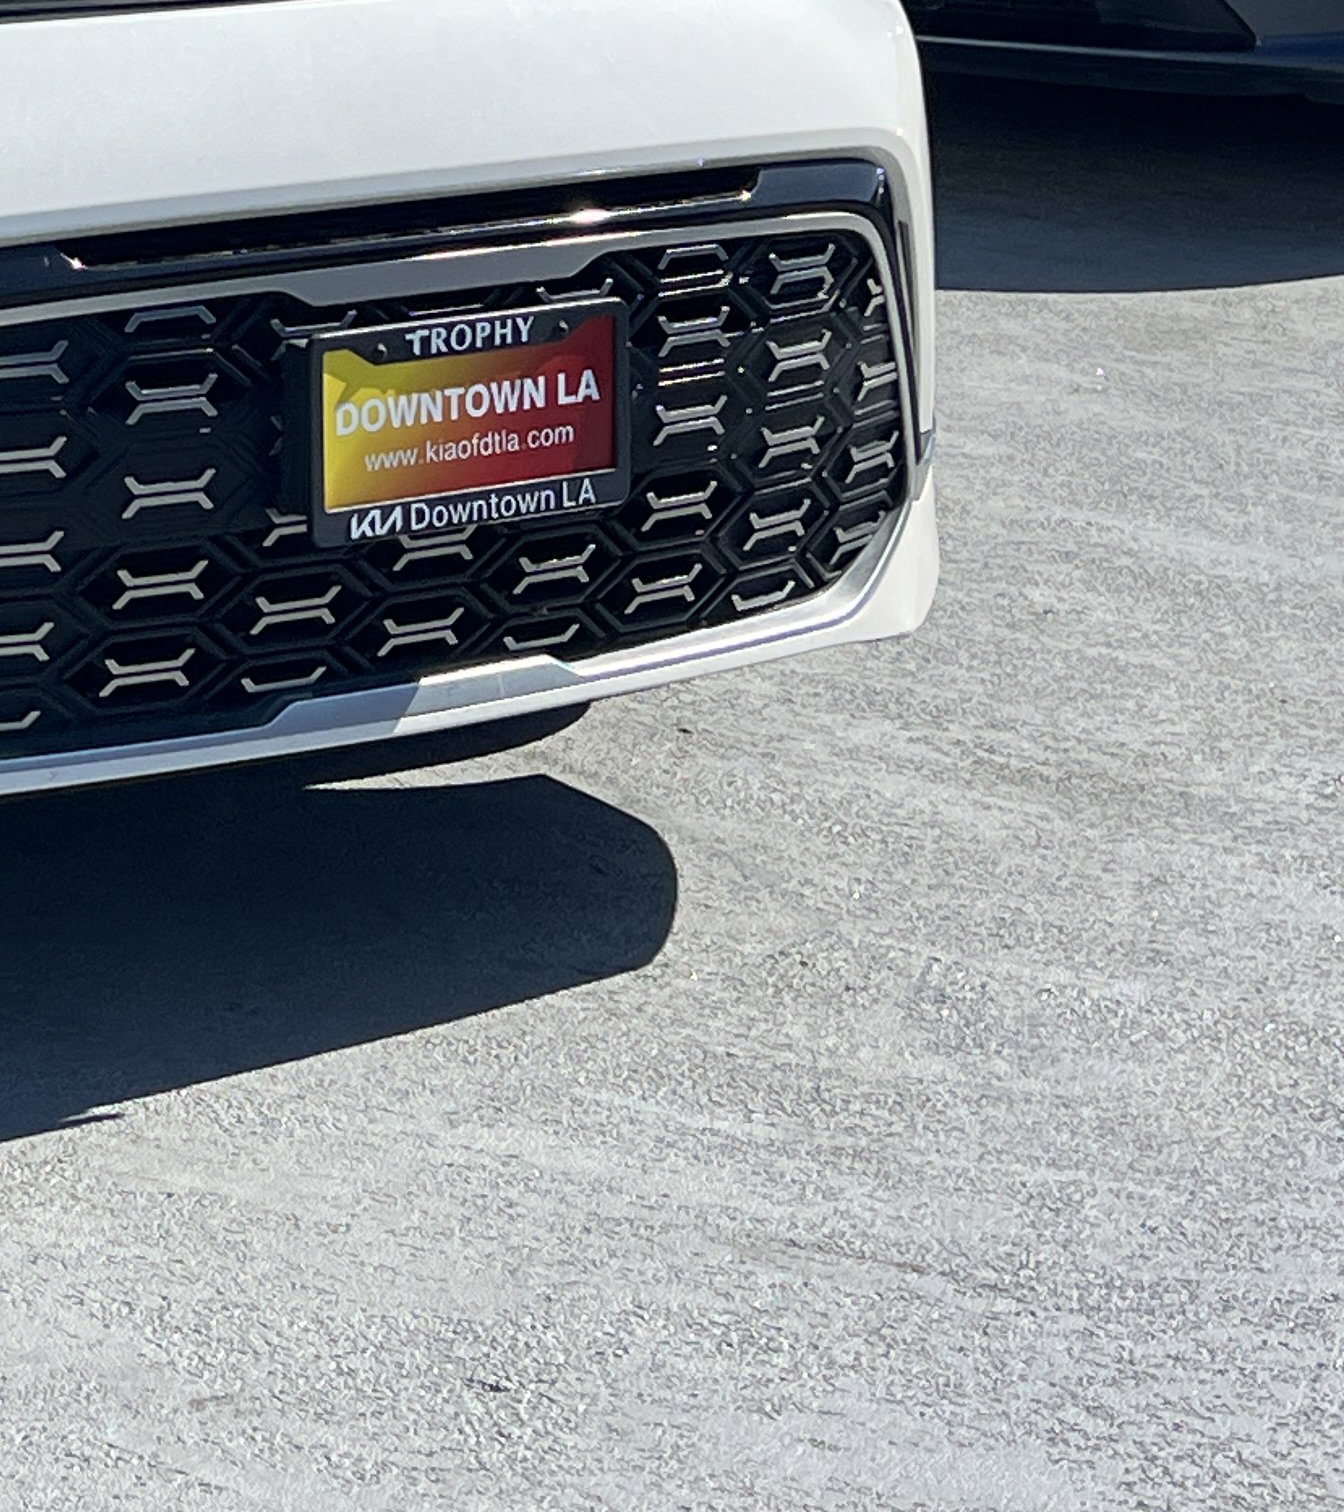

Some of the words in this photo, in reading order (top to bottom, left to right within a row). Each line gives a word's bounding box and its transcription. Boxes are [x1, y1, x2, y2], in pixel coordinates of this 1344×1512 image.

[405, 315, 535, 356] TROPHY
[334, 377, 547, 437] DOWNTOWN
[557, 369, 601, 406] LA
[364, 423, 575, 472] www.kiaofdtla.com
[349, 506, 403, 540] KIA
[411, 489, 556, 531] Downtown
[562, 477, 597, 507] LA
